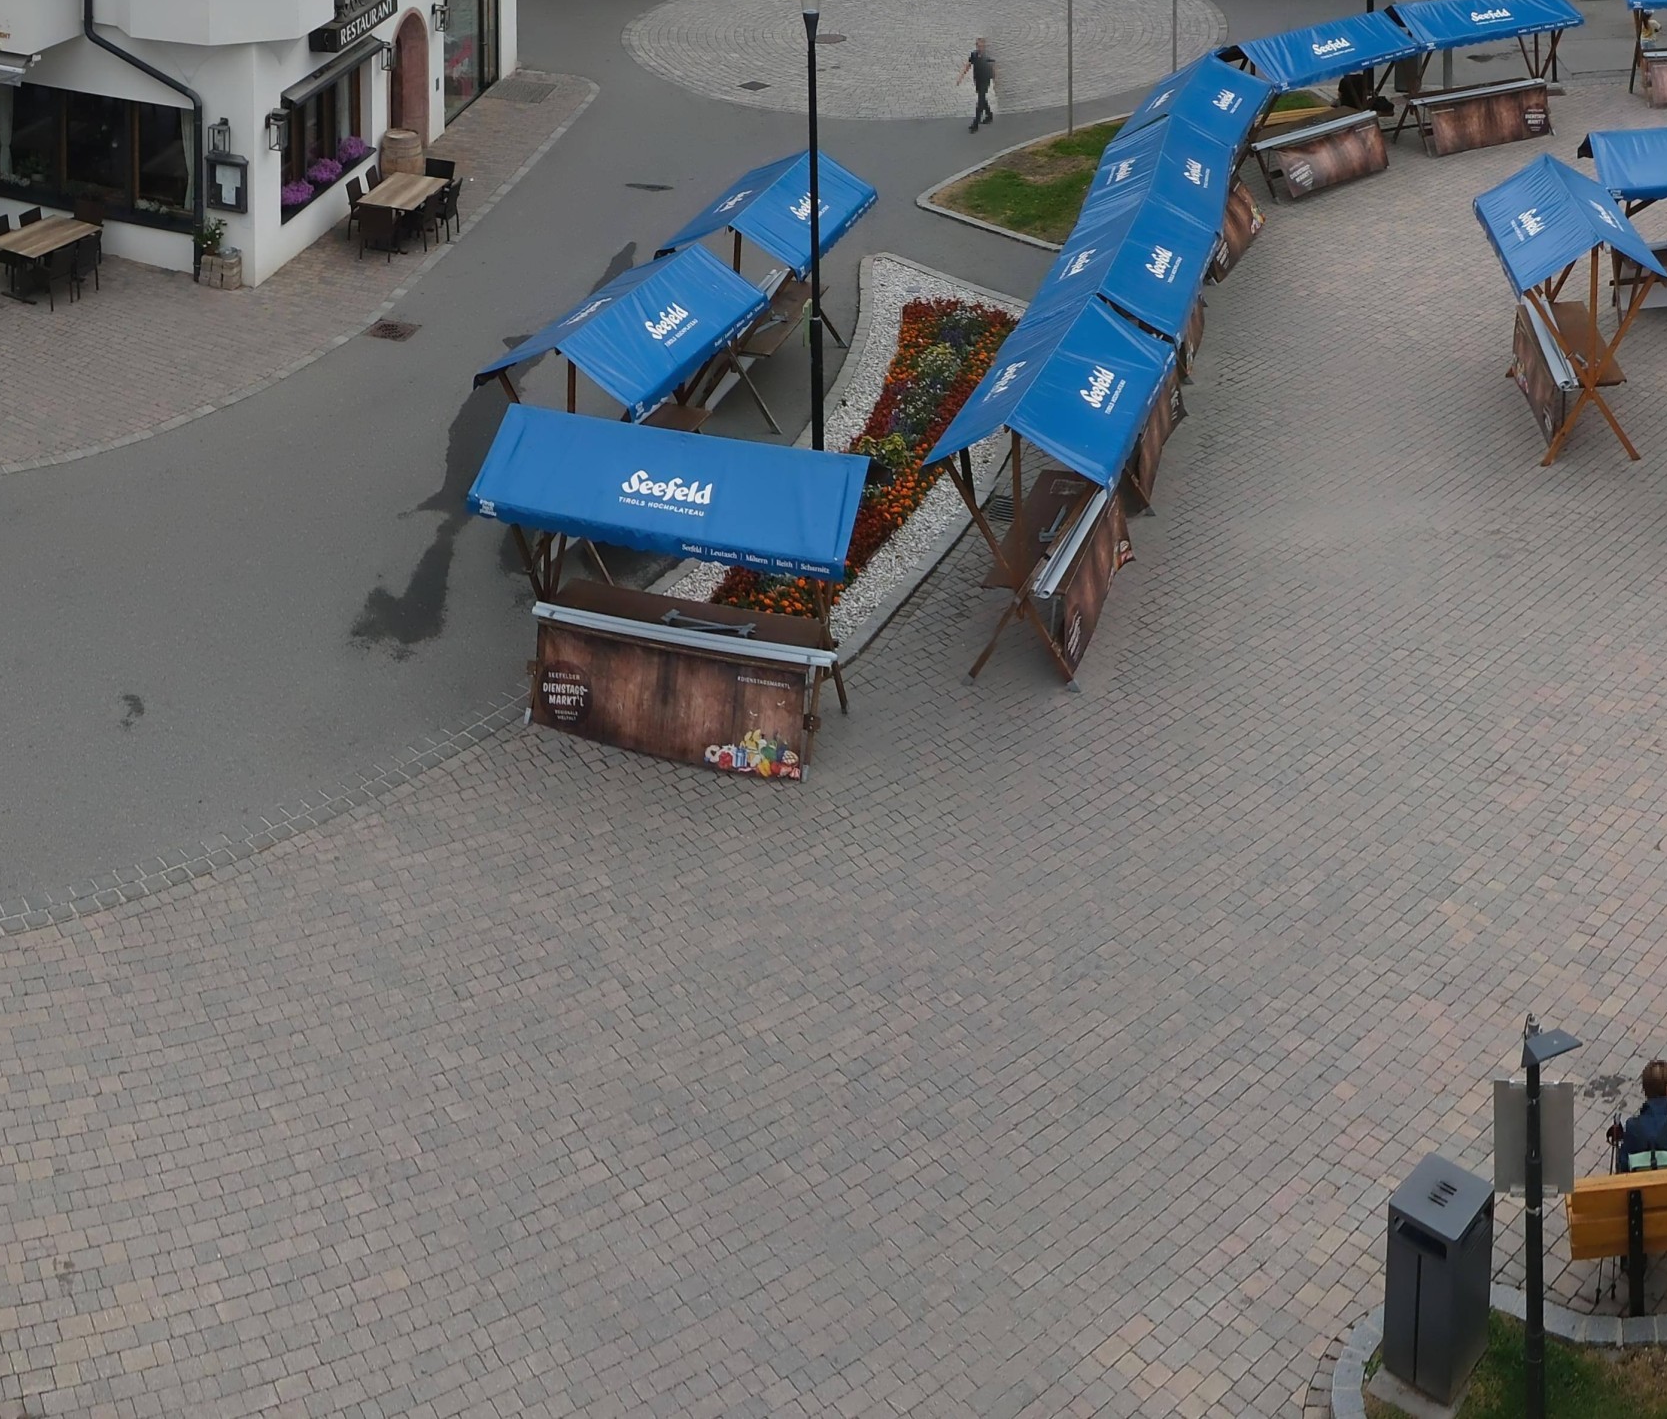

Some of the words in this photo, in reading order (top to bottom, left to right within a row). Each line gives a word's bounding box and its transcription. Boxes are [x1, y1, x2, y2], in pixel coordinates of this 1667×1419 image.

[1470, 8, 1511, 22] Seefeld
[1312, 37, 1351, 56] Seefeld
[1518, 208, 1545, 237] Seefeld
[1145, 245, 1173, 279] Seefeld
[644, 301, 689, 340] Seefeld
[1080, 365, 1116, 409] Seefeld
[621, 469, 713, 505] Seefeld
[618, 496, 646, 507] TIROLS
[648, 502, 705, 517] HOCHPLATEAU
[548, 671, 581, 680] SEEFELDER
[542, 681, 588, 696] DIENSTAGS-
